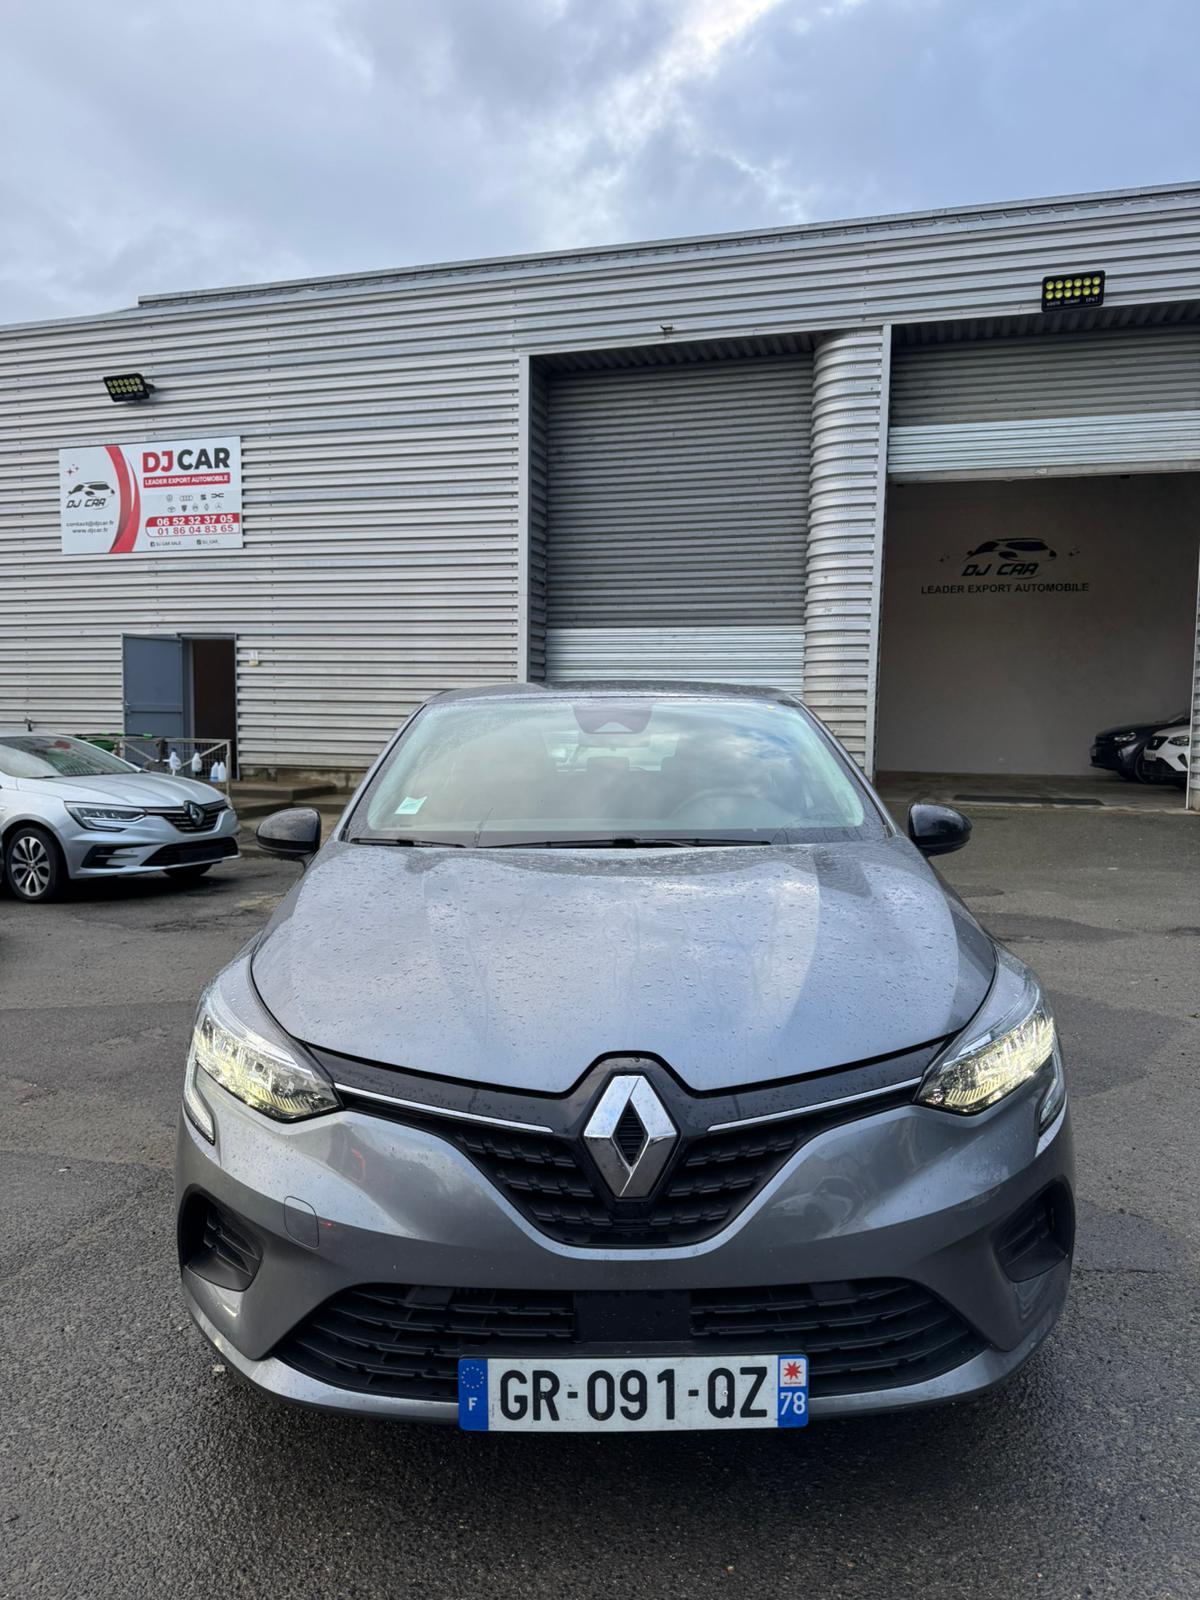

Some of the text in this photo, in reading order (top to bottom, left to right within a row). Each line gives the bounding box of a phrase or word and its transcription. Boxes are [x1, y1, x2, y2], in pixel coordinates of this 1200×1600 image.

[142, 447, 231, 473] DJ CAR
[191, 474, 229, 483] AUTOMOBILE
[66, 497, 107, 508] DJ CAR
[156, 514, 234, 526] 06 52 32 37 05
[157, 527, 169, 536] 01
[189, 526, 201, 534] 04
[220, 524, 234, 532] 65
[961, 562, 1039, 577] DJ CAR
[921, 582, 1090, 595] LEADER EXPORT AUTOMOBILE
[500, 1366, 768, 1422] GR-091-QZ
[468, 1397, 478, 1412] F
[780, 1391, 806, 1416] 78
